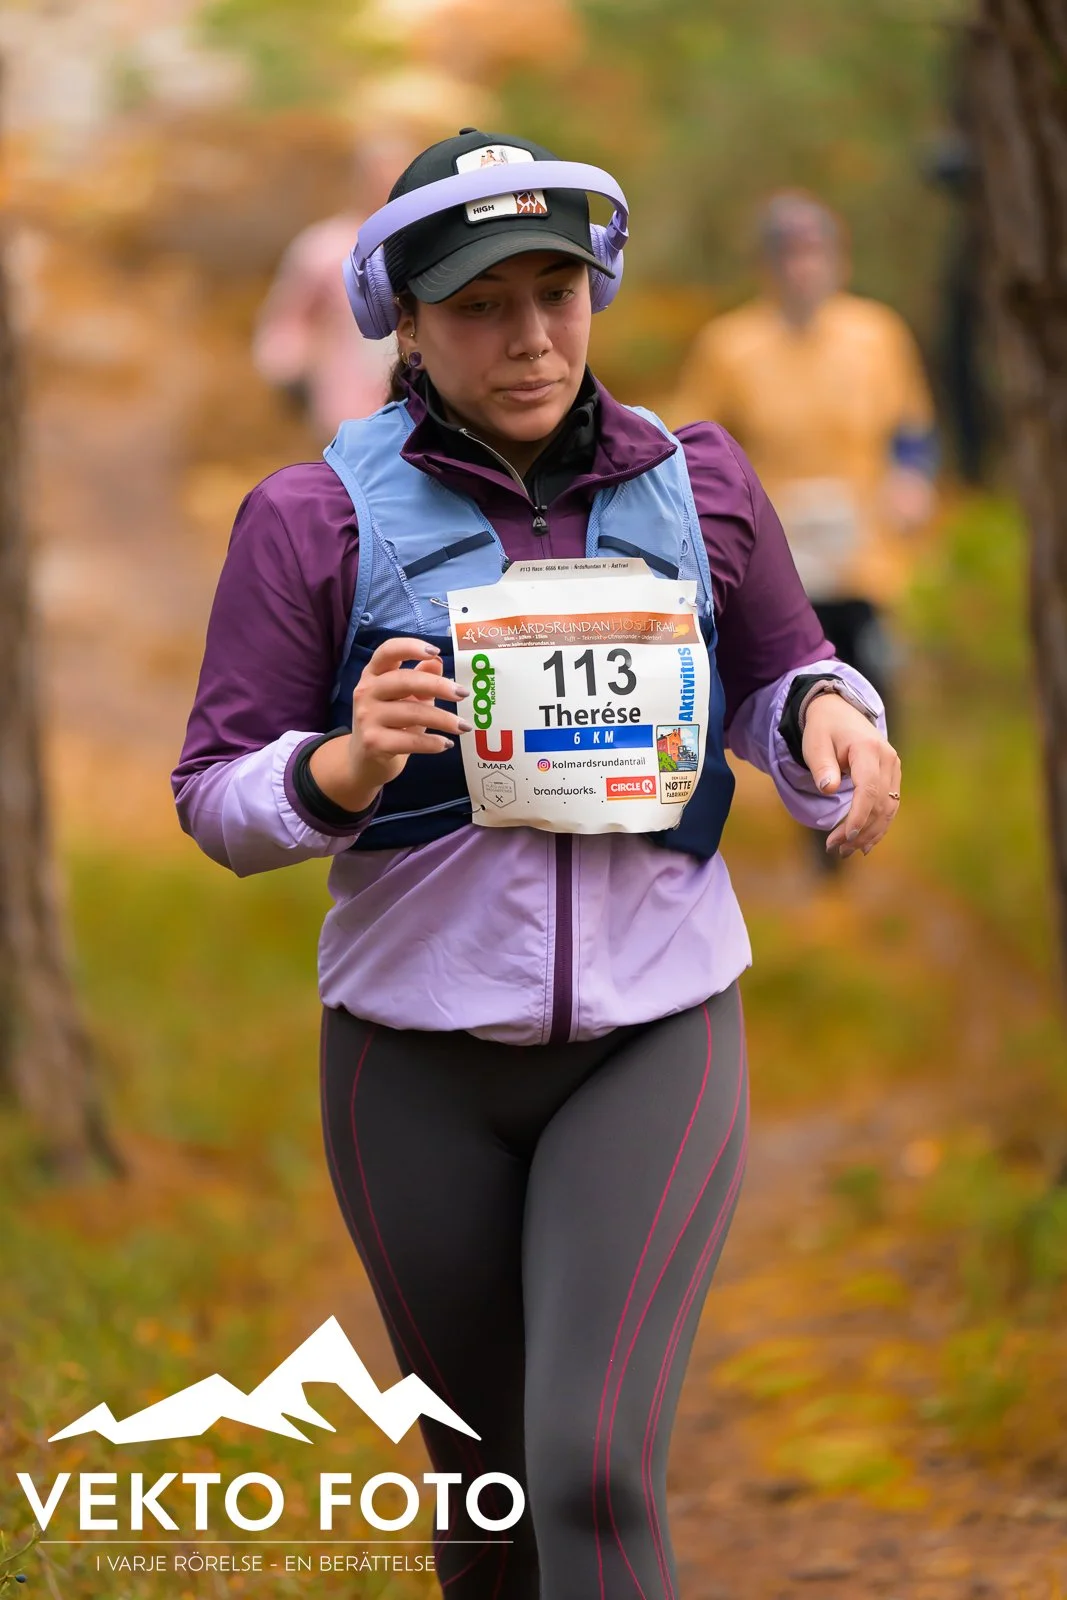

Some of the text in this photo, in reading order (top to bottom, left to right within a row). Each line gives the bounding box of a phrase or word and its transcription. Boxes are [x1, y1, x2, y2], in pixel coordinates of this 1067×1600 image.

[473, 204, 494, 214] HIGH
[544, 648, 636, 697] 113
[678, 647, 695, 722] Aktivitus
[472, 654, 495, 729] coop
[539, 702, 641, 727] Therése
[573, 732, 581, 745] 6
[478, 762, 514, 770] UMARA
[552, 757, 646, 769] kolmardsrundantrail
[534, 786, 596, 796] brandworks.
[610, 782, 640, 792] CIRCLE
[665, 780, 692, 790] NØTTE
